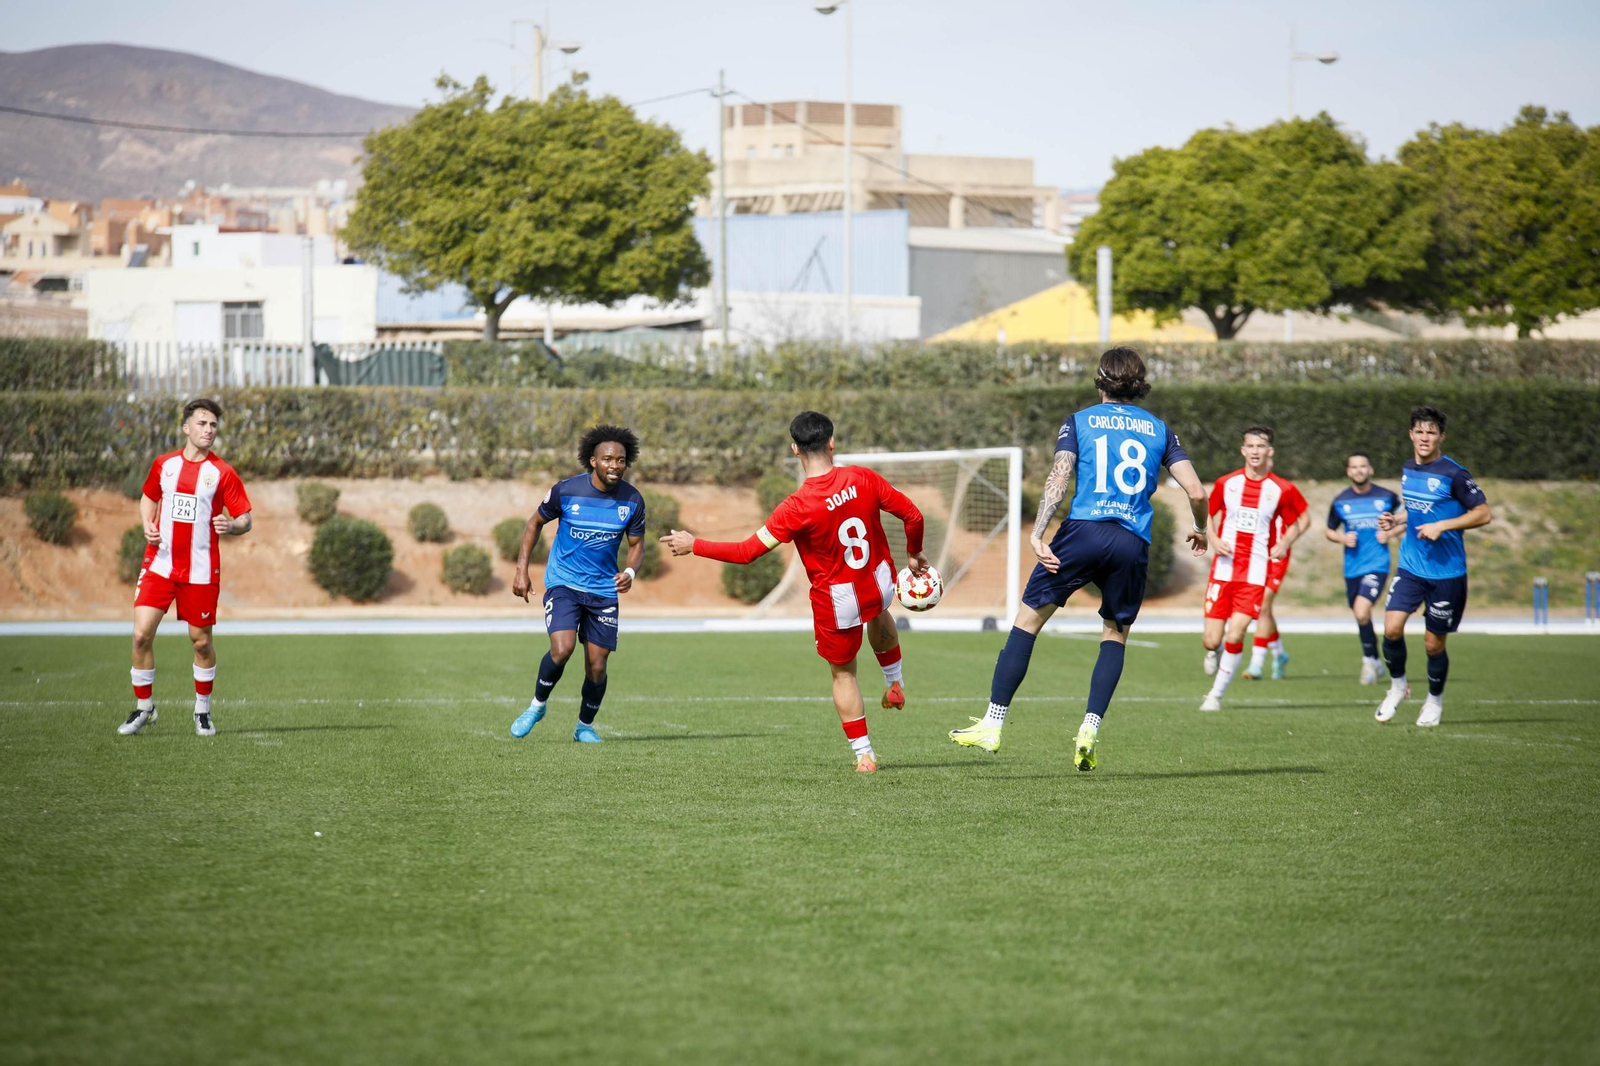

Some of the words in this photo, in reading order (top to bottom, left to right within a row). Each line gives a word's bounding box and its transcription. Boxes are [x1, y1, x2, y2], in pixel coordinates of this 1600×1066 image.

[1088, 414, 1124, 430] CARLOS
[1125, 417, 1157, 437] DANIEL
[1093, 434, 1147, 496] 18
[825, 485, 857, 512] JOAN
[837, 516, 870, 570] 8
